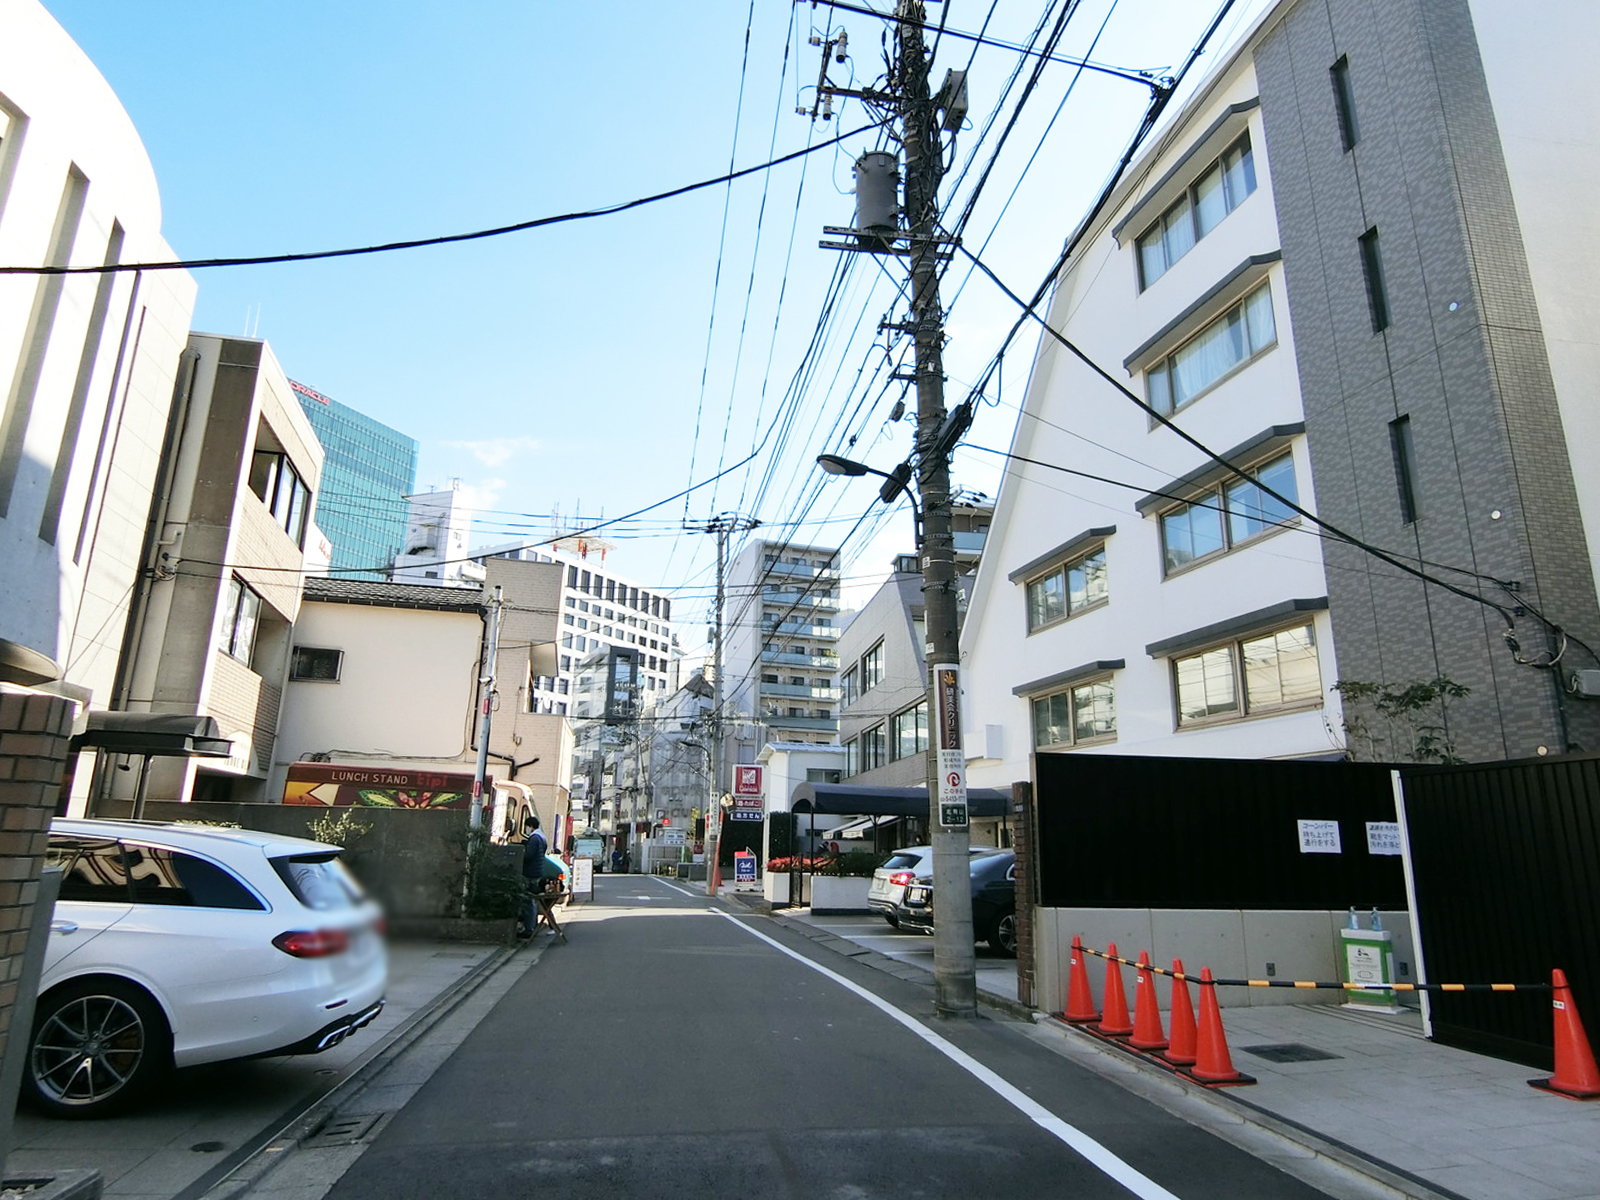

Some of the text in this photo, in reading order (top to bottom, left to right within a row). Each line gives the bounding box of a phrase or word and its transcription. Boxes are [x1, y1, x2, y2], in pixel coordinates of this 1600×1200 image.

[289, 380, 330, 406] ORACLE
[331, 771, 369, 782] LUNCH
[372, 773, 408, 785] STAND
